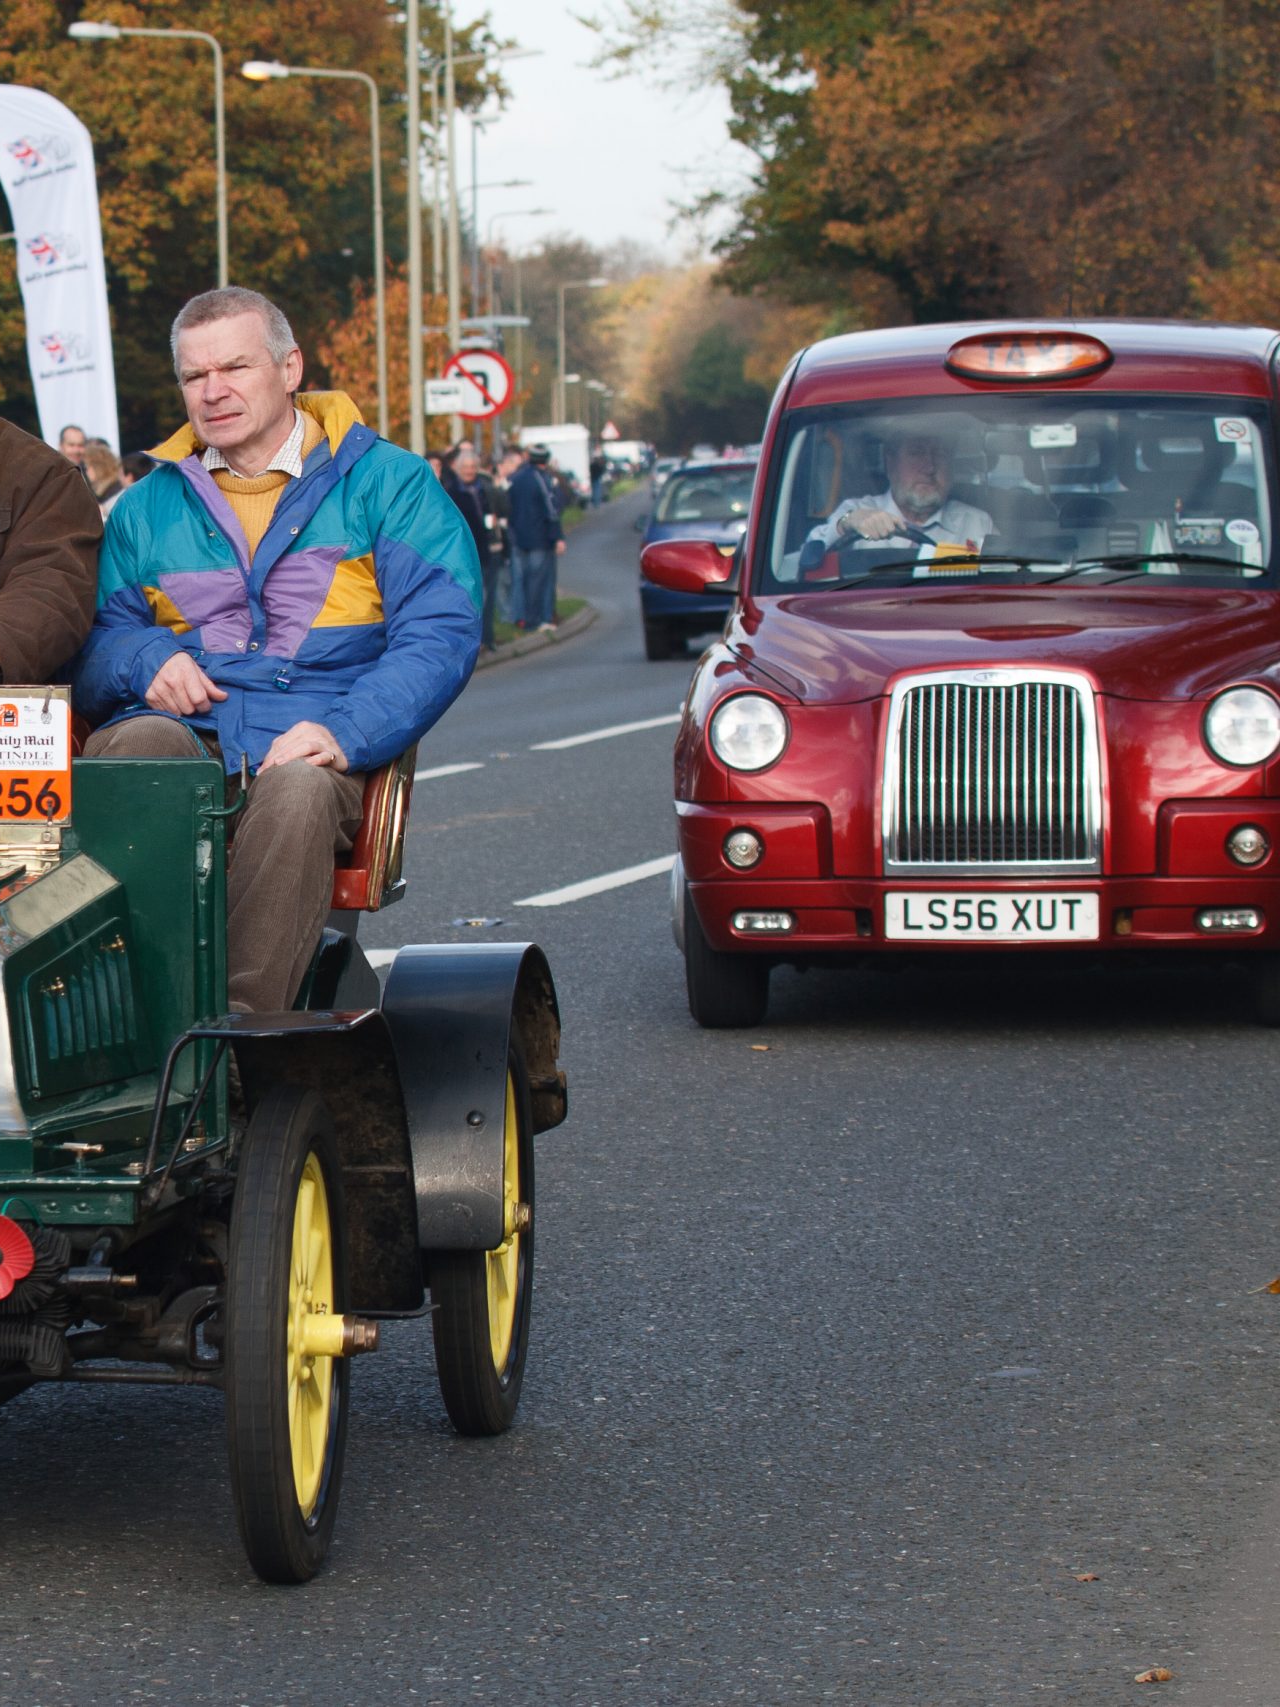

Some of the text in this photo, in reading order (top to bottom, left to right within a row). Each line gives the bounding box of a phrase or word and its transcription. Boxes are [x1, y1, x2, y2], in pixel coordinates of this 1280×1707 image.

[981, 337, 1073, 369] TAXI
[24, 735, 54, 746] Mail
[903, 899, 1082, 931] LS56 XUT
